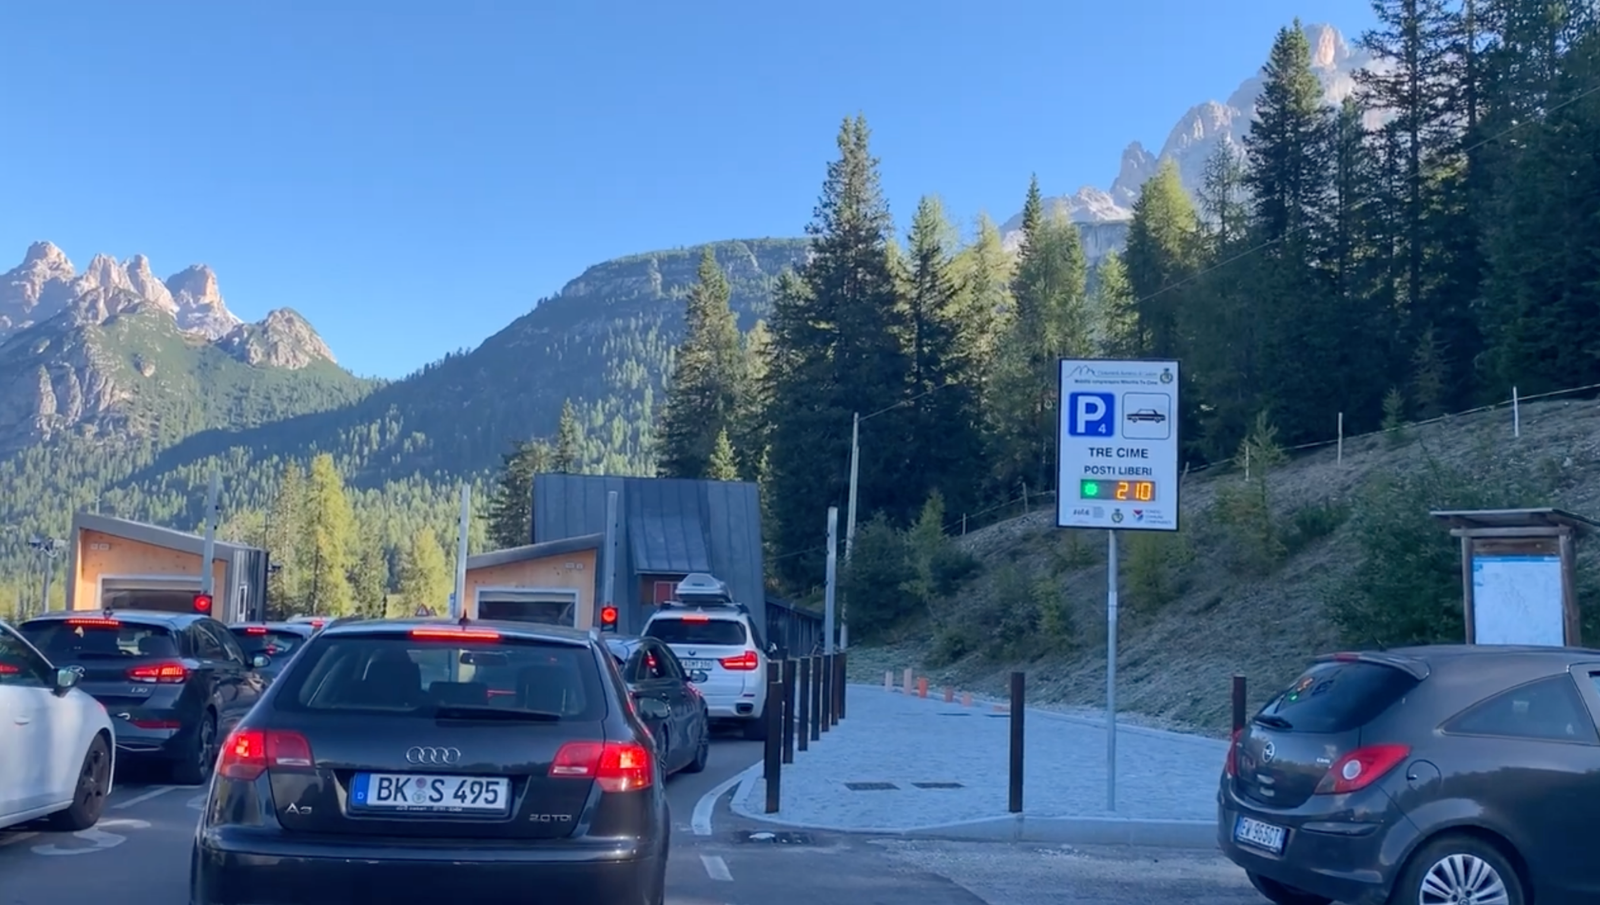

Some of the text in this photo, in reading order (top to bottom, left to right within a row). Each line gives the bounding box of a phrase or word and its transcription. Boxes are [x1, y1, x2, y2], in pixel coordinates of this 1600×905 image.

[1076, 395, 1106, 434] P
[1097, 423, 1107, 434] 4
[1088, 447, 1149, 459] TRE CIME
[1084, 465, 1153, 476] POSTI LIBERI
[1116, 481, 1152, 501] 210
[376, 777, 500, 805] BK S 495
[284, 802, 312, 816] A3
